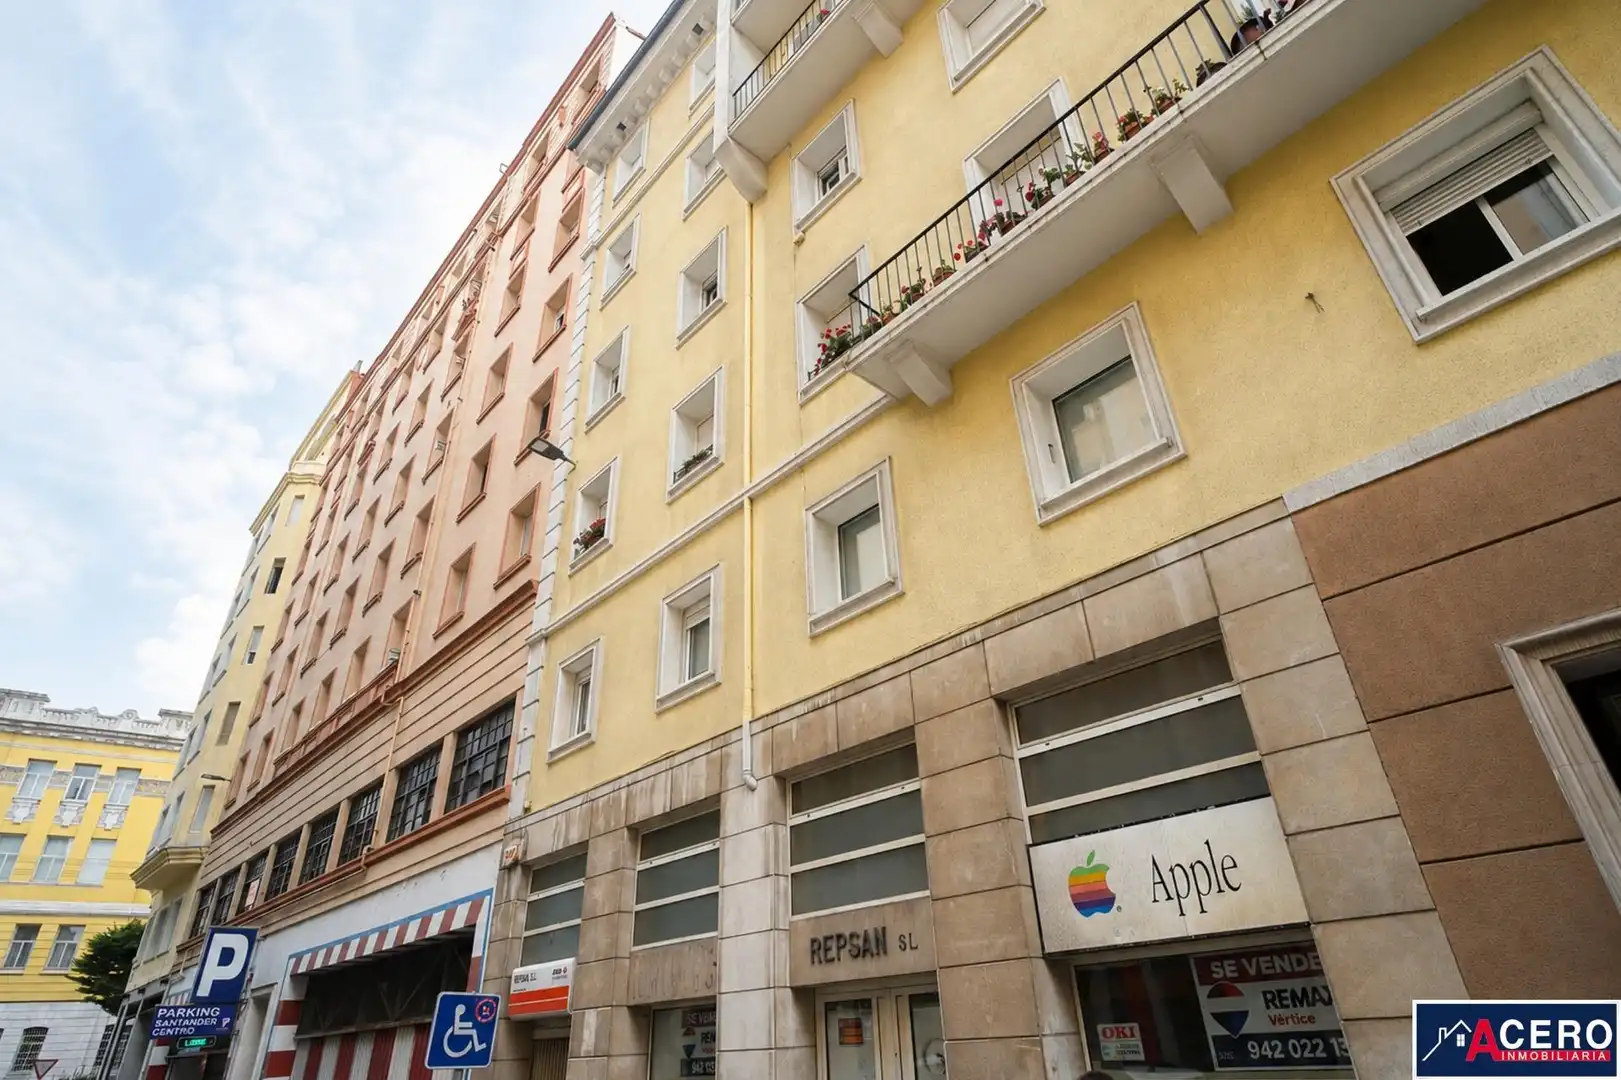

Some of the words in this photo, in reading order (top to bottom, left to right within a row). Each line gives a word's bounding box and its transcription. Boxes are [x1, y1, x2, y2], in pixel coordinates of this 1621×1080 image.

[1151, 839, 1242, 917] Apple
[810, 926, 888, 965] REPSAN
[898, 932, 919, 952] SL
[196, 933, 249, 997] P
[1211, 959, 1239, 979] SE
[1241, 952, 1321, 977] VENDE
[155, 1017, 218, 1028] SANTANDER
[157, 1006, 220, 1018] PARKING
[152, 1026, 195, 1036] CENTRO
[1101, 1026, 1138, 1040] OKI
[1247, 1039, 1285, 1060] 942
[1288, 1037, 1327, 1058] 022
